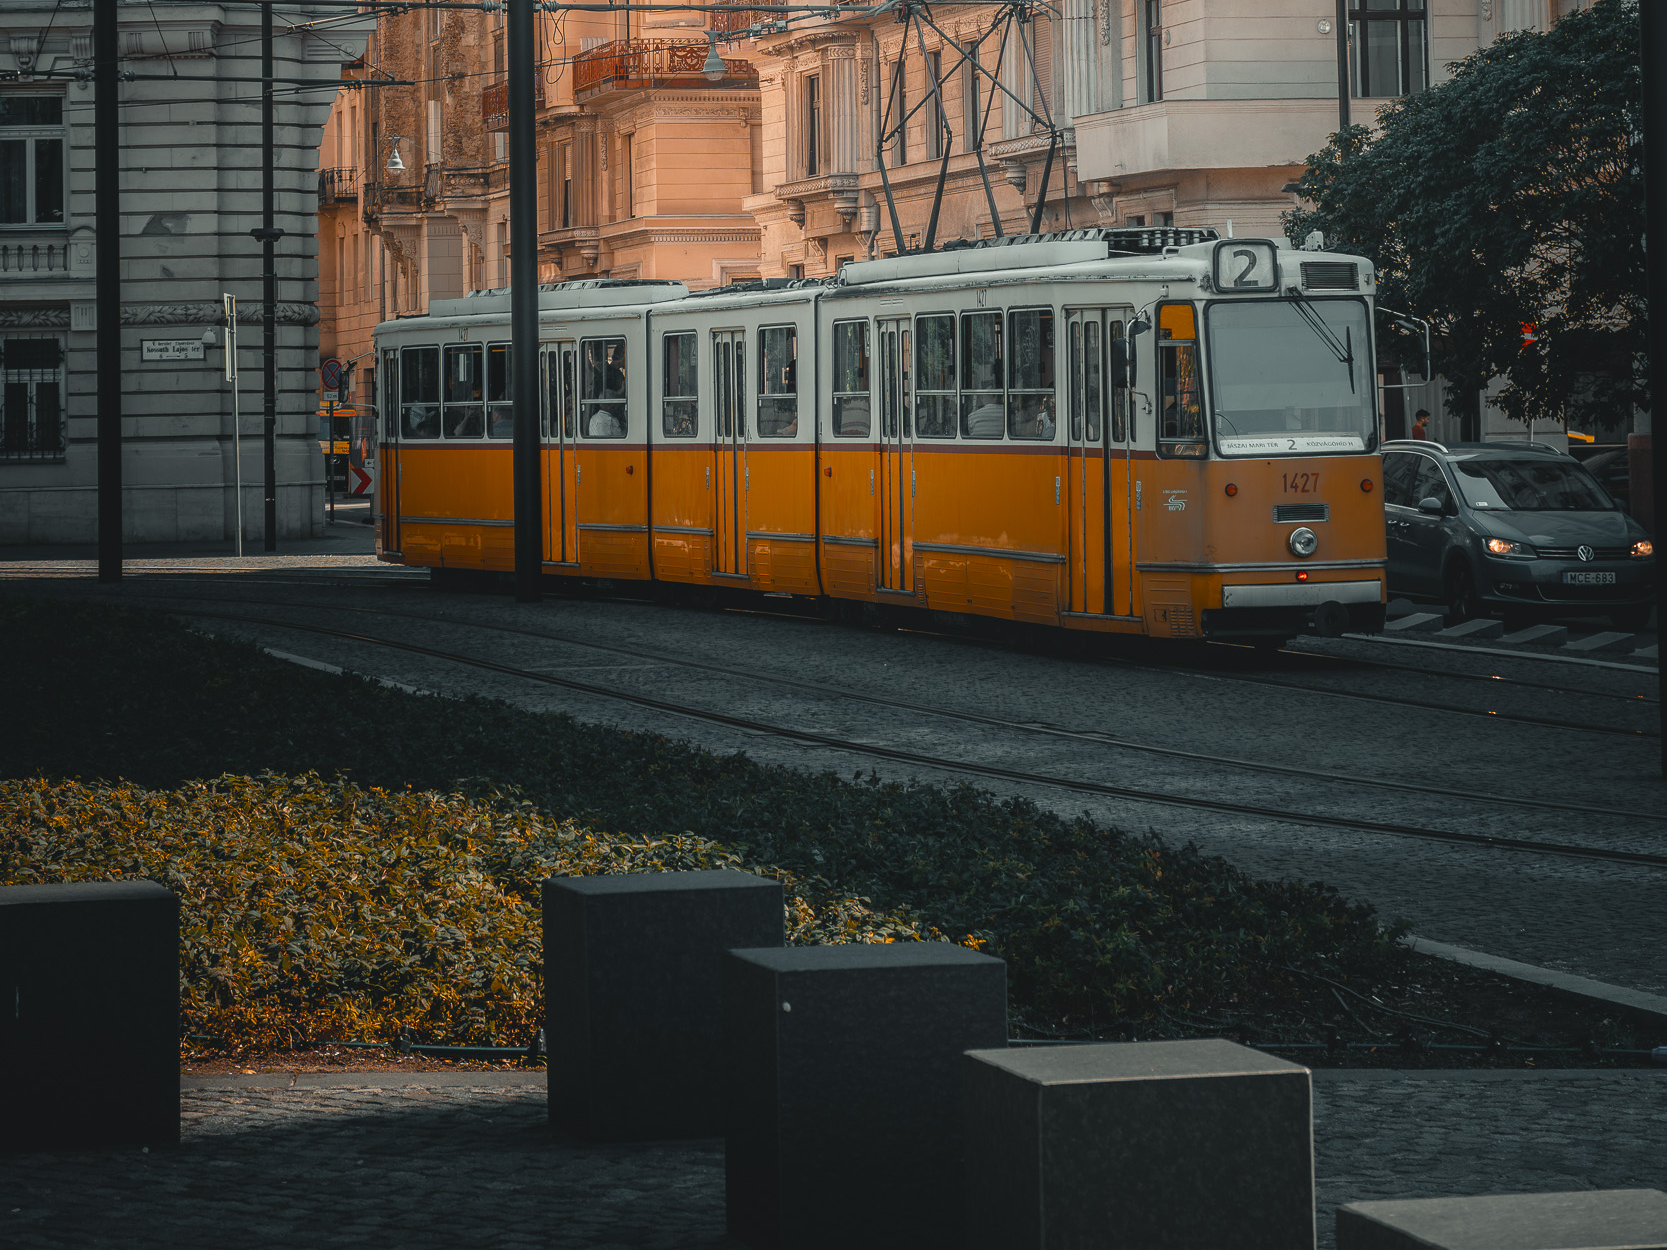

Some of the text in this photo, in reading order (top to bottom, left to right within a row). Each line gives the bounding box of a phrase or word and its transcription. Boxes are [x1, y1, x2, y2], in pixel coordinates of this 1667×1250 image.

[1233, 249, 1259, 287] 2
[1286, 439, 1298, 450] 2
[1282, 472, 1320, 493] 1427
[1570, 573, 1614, 583] MCE-683
